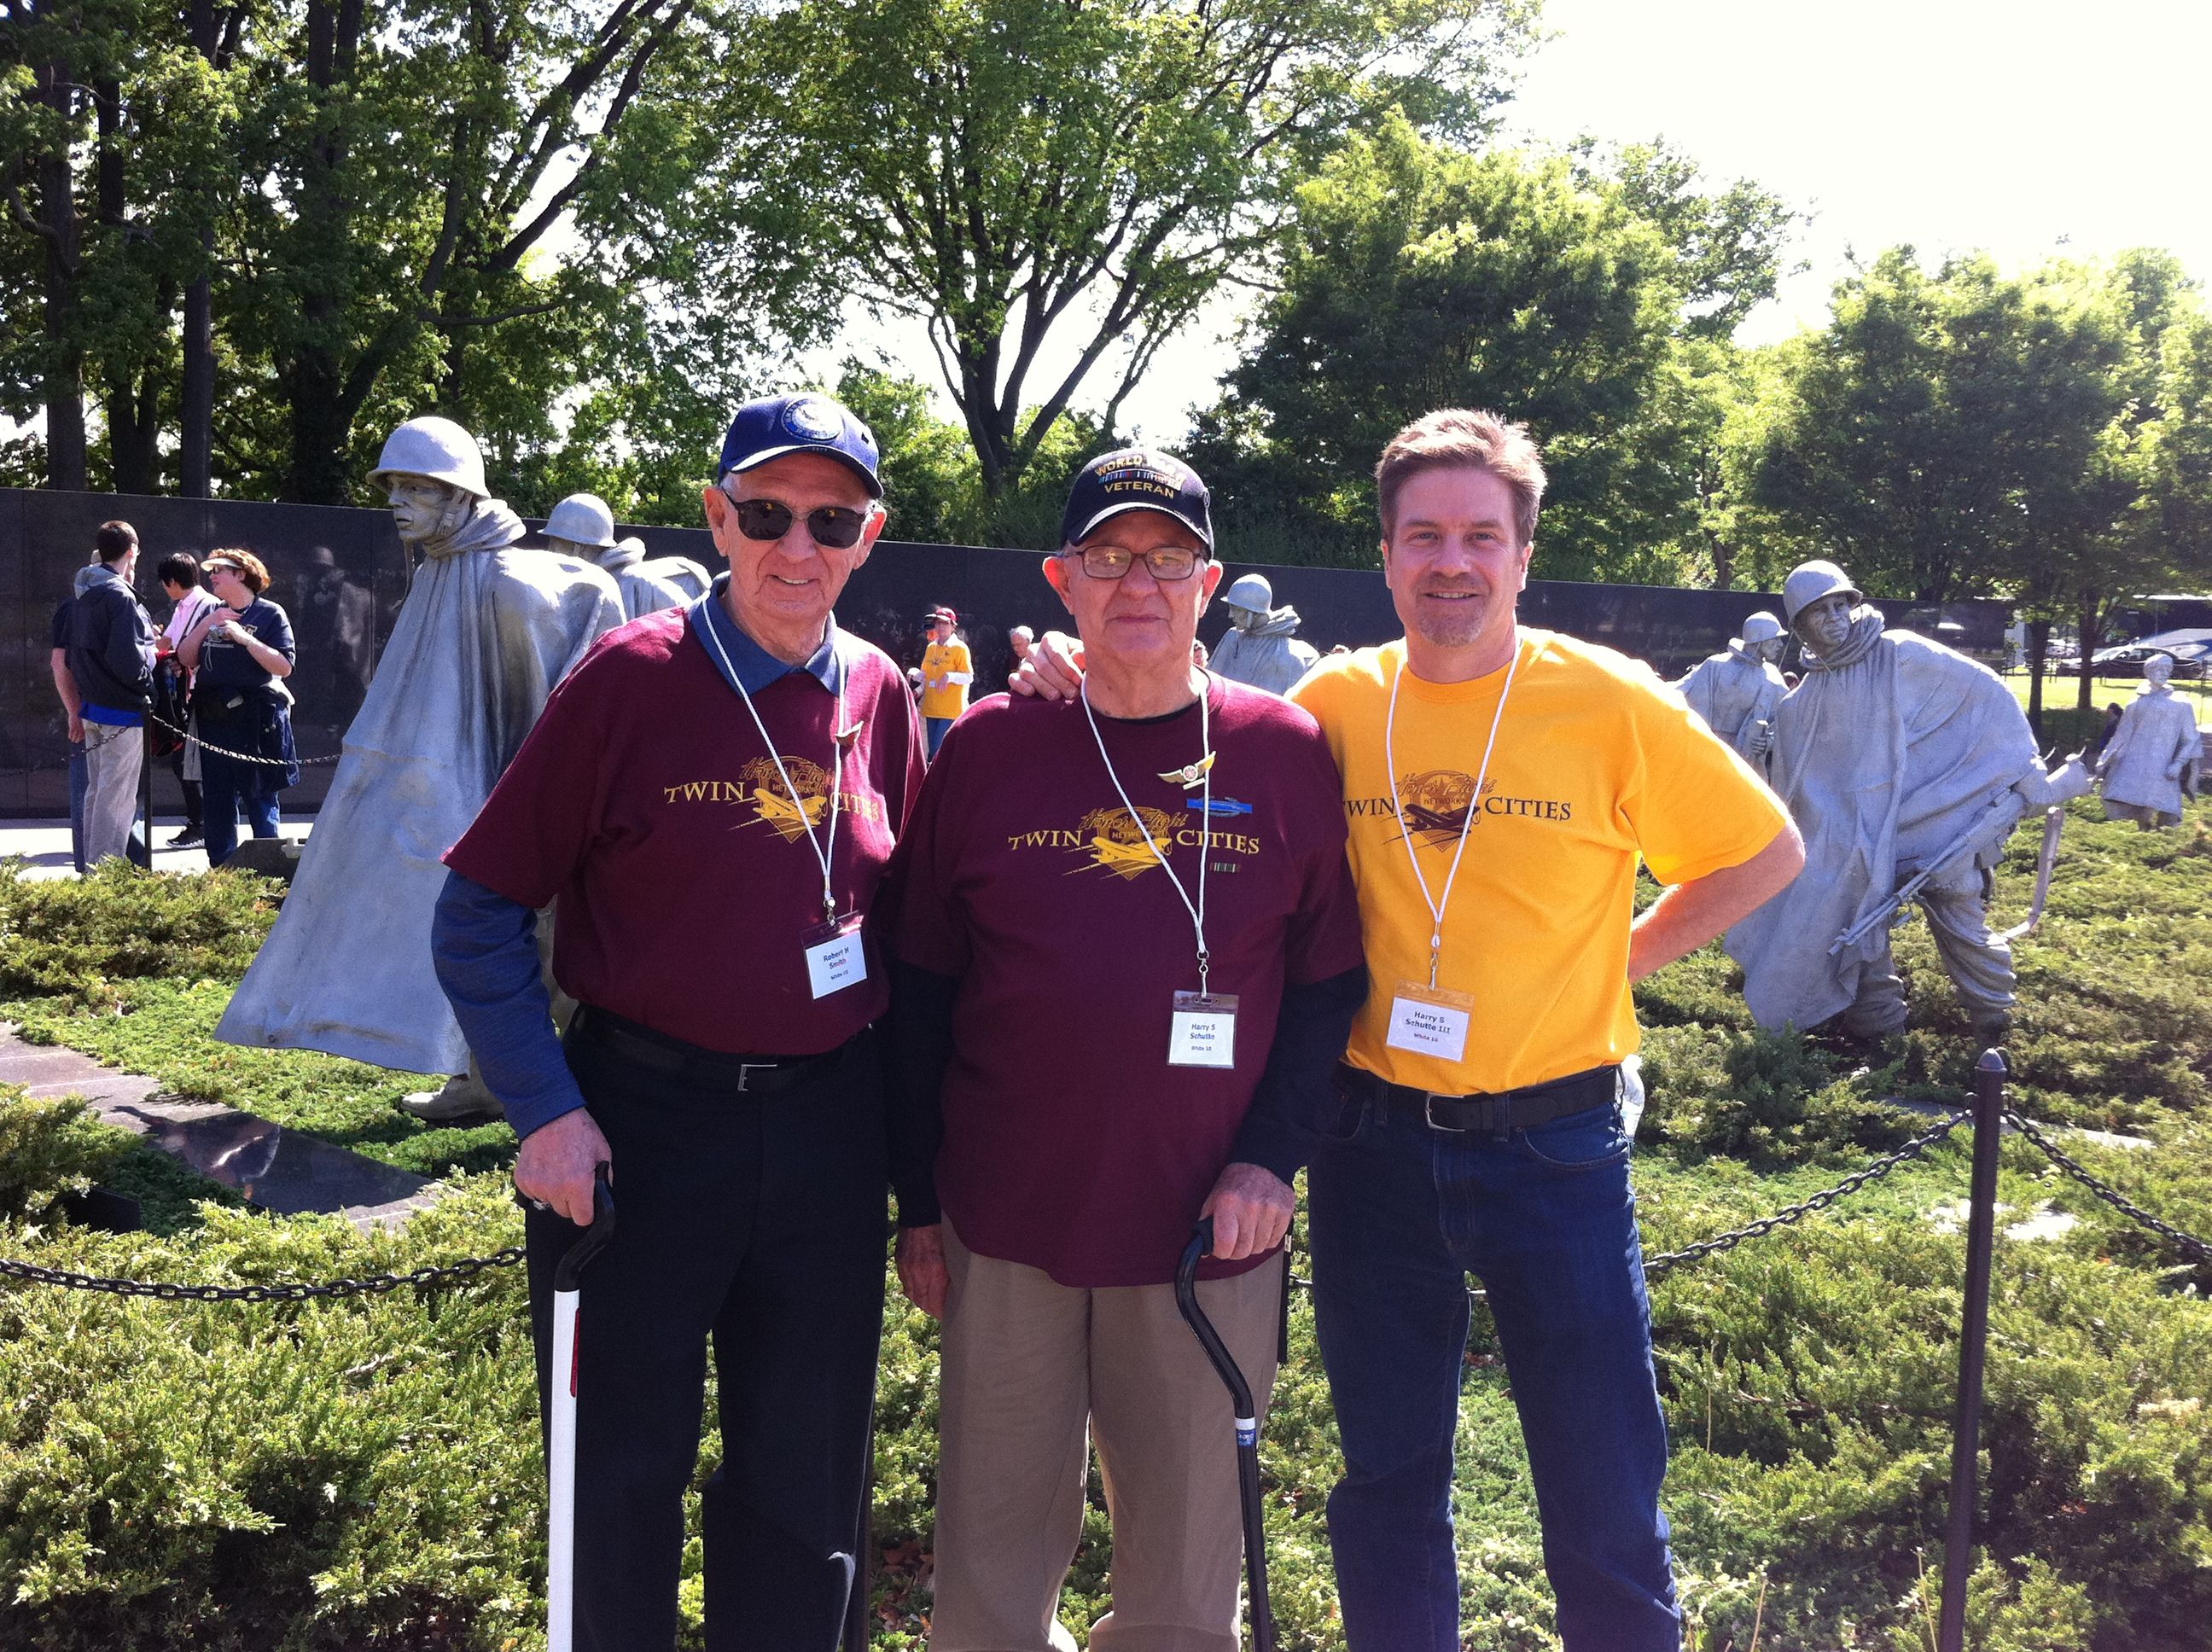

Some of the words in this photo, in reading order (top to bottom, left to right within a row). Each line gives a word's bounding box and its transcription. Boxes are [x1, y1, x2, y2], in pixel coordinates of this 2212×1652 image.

[1095, 455, 1144, 477] WORLD
[1104, 481, 1175, 499] VETERAN
[664, 781, 746, 804] TWIN
[1423, 797, 1462, 806] NETWORK
[1343, 797, 1397, 817] WIN
[1485, 796, 1572, 821] CITIES
[1008, 829, 1082, 851] TWIN
[1176, 829, 1260, 854] CITIES
[1414, 1011, 1437, 1023] Harry
